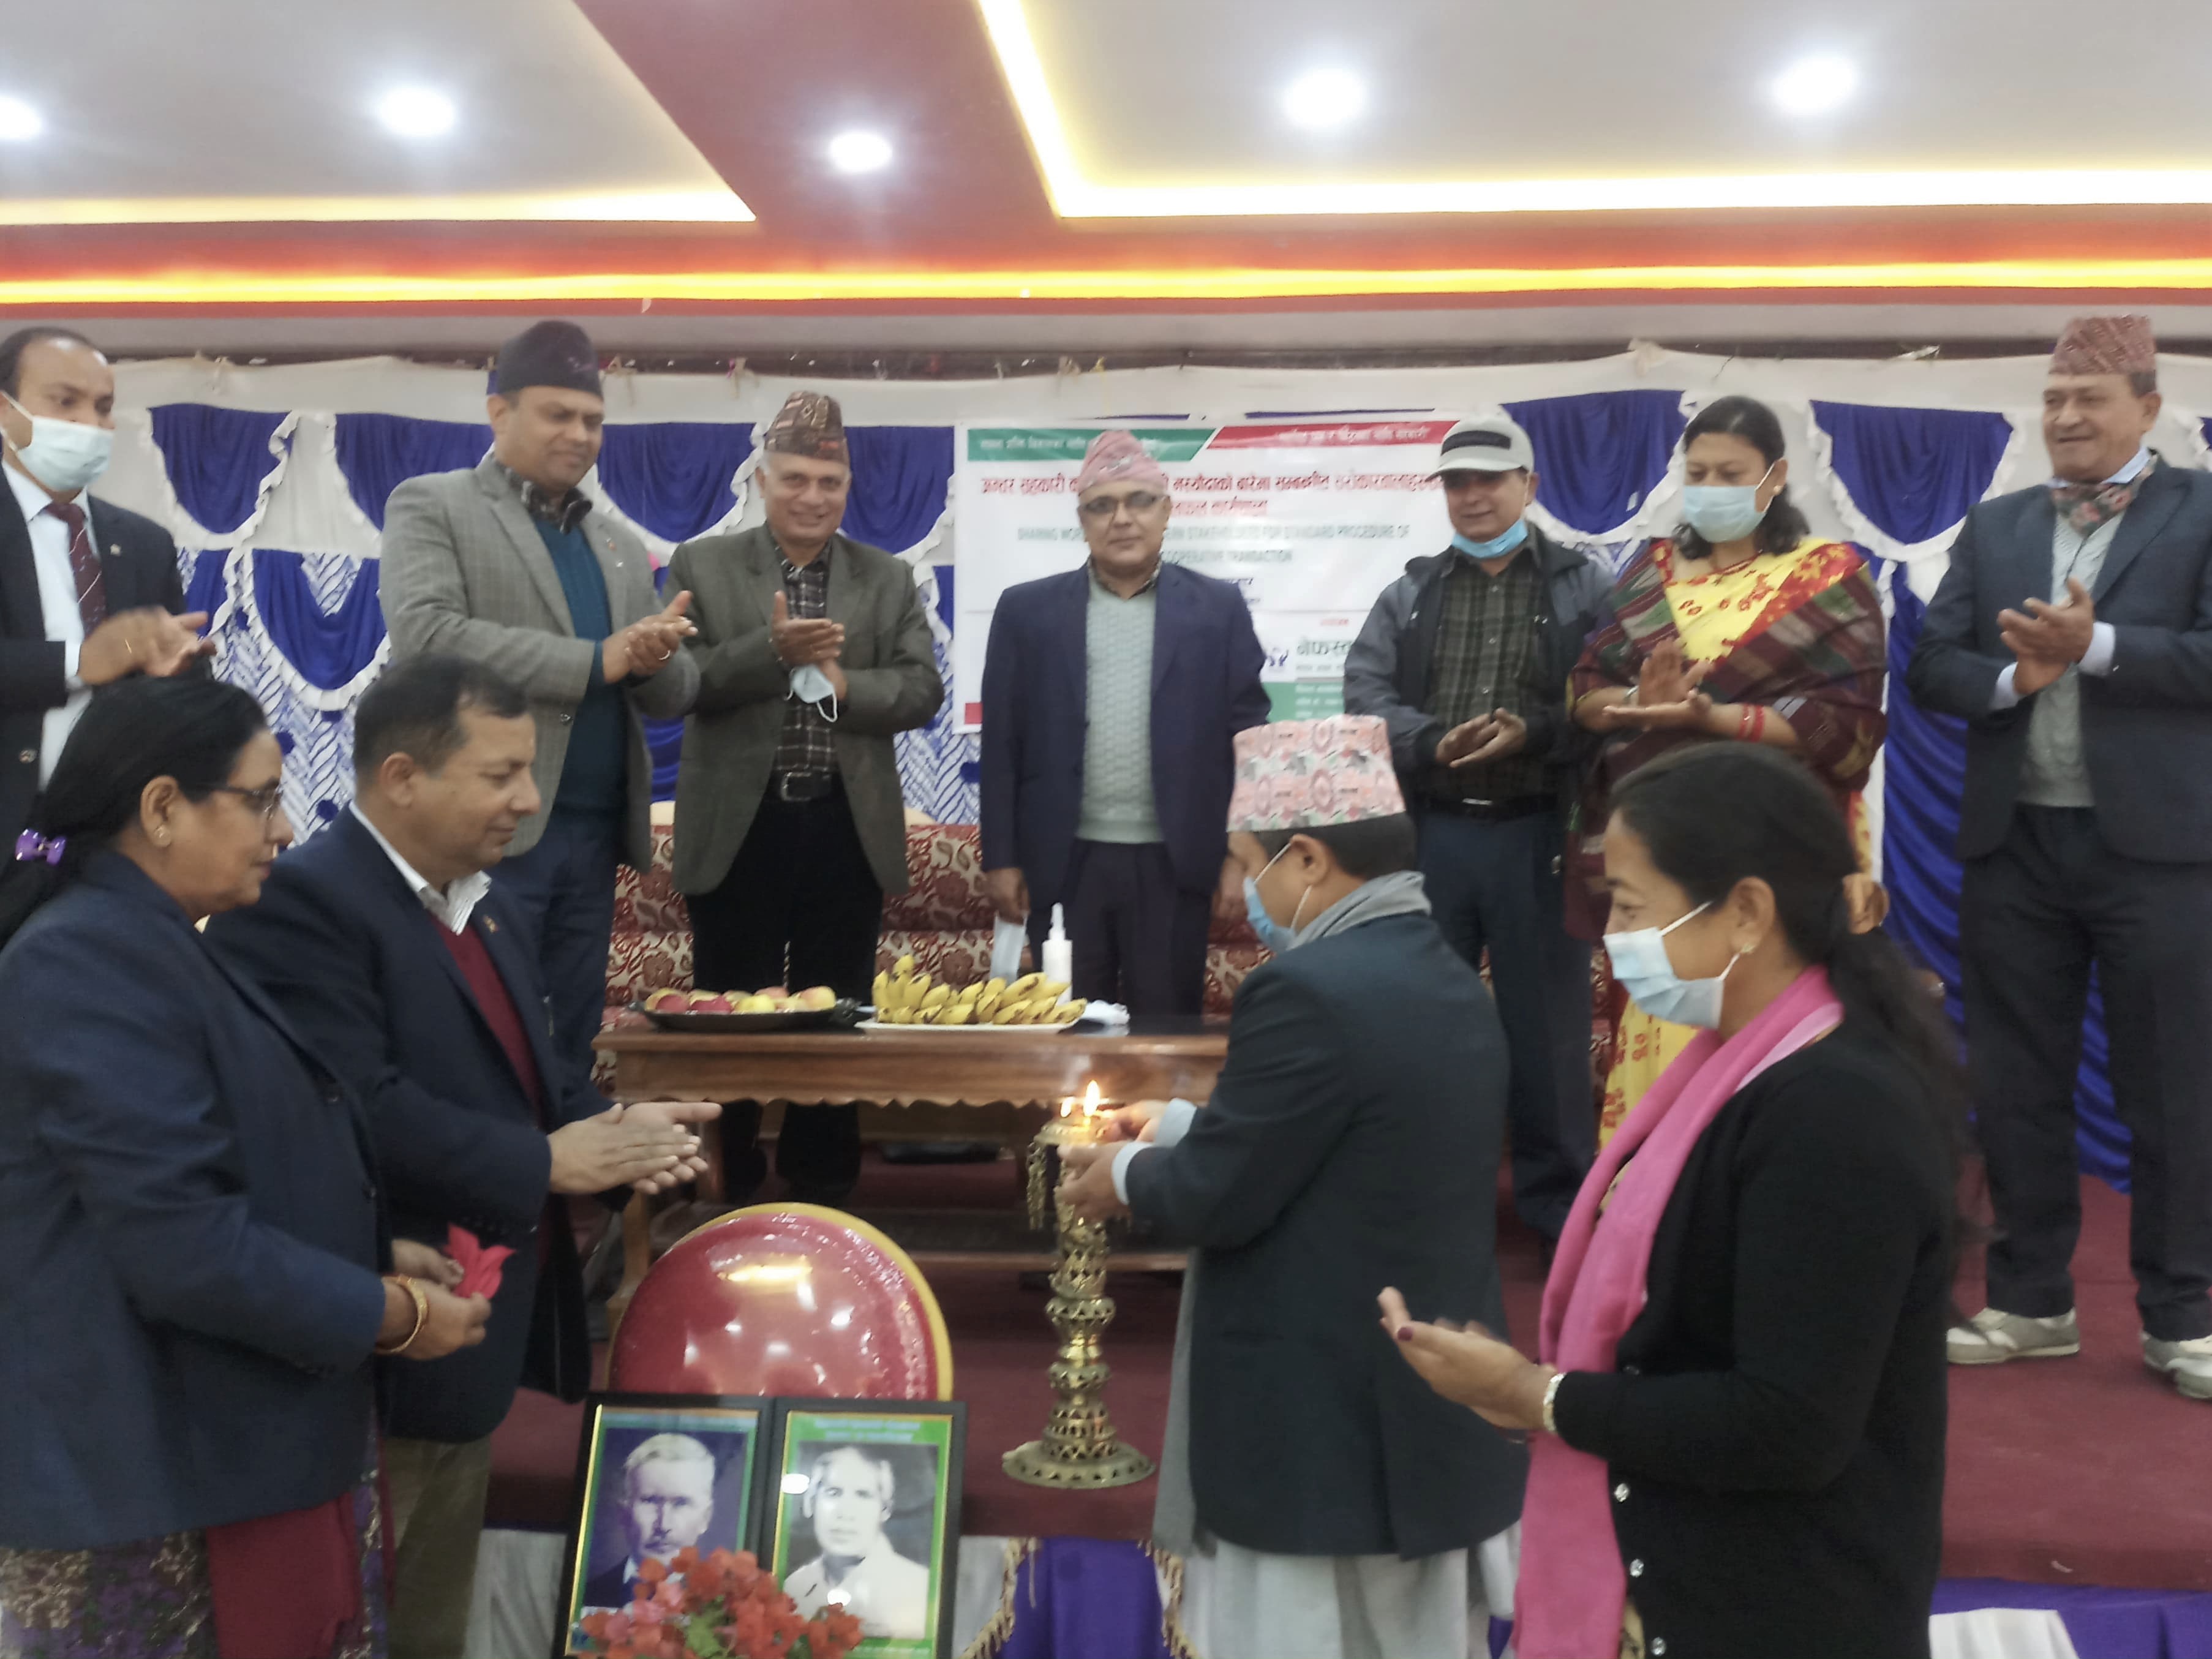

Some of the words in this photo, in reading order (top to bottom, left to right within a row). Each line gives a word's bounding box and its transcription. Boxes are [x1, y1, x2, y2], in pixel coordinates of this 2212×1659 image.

[1020, 472, 1065, 495] सहकारी
[1337, 524, 1393, 539] PROCEDURE
[1396, 524, 1410, 538] OF
[1227, 549, 1292, 562] TRANSACTION
